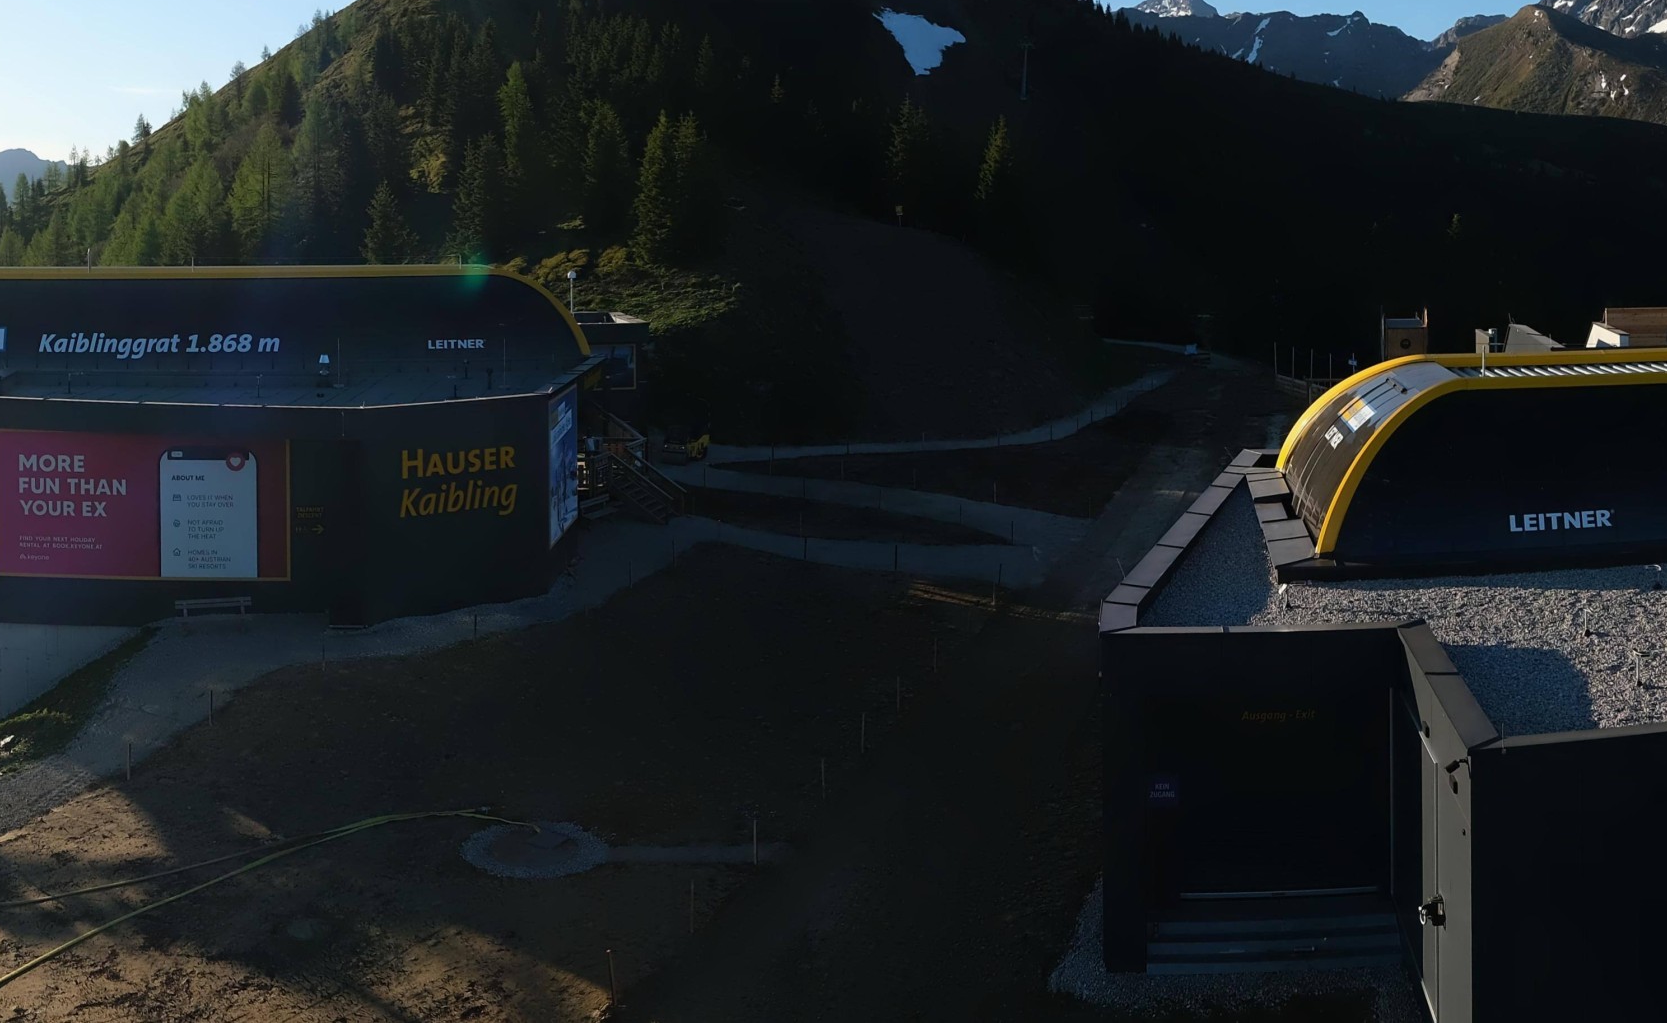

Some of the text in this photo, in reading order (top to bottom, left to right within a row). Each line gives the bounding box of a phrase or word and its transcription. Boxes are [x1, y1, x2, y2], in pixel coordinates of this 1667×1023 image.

[38, 333, 280, 359] Kaiblinggrat 1.868 m
[427, 339, 486, 349] LEITNER
[18, 453, 86, 473] MORE
[401, 445, 517, 480] HAUSER
[18, 477, 127, 496] FUN THAN
[19, 499, 107, 517] YOUR EX
[400, 479, 519, 518] Kaibling
[1508, 509, 1613, 533] LEITNER
[1241, 710, 1287, 722] Ausgang
[1295, 709, 1316, 721] Exit
[1149, 790, 1175, 798] ZUGANG
